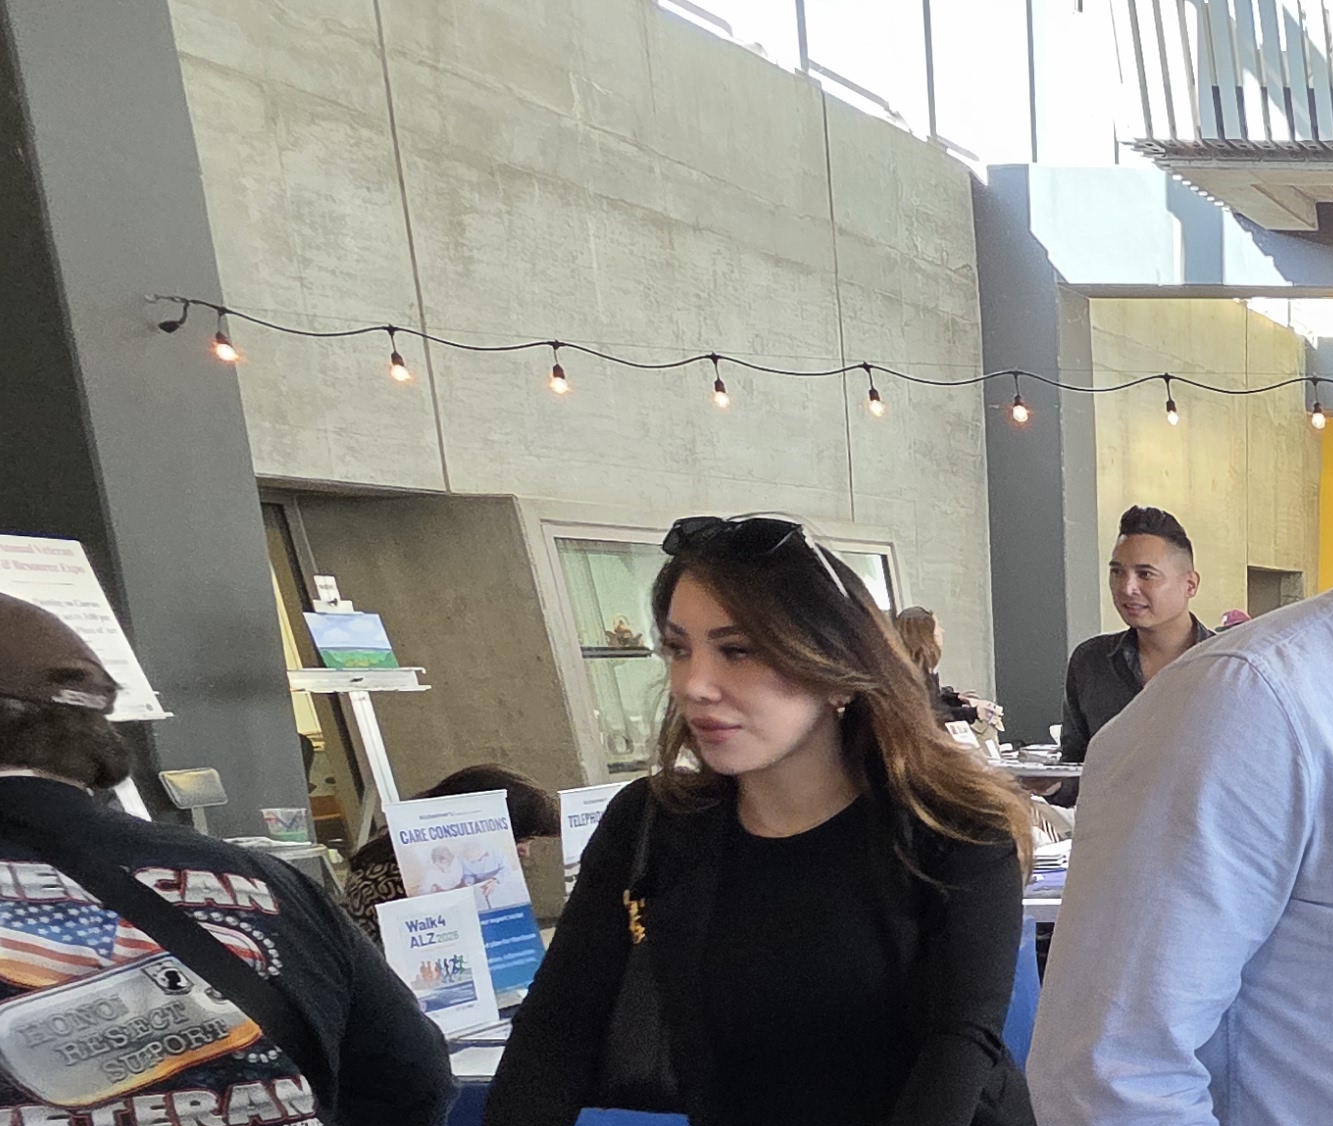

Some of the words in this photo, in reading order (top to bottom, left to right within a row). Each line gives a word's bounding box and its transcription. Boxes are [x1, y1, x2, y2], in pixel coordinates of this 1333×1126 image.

[399, 828, 430, 846] CARE
[430, 817, 510, 842] CONSULTATIONS
[405, 916, 447, 934] Walk4
[410, 933, 437, 949] ALZ
[17, 992, 130, 1048] HONO
